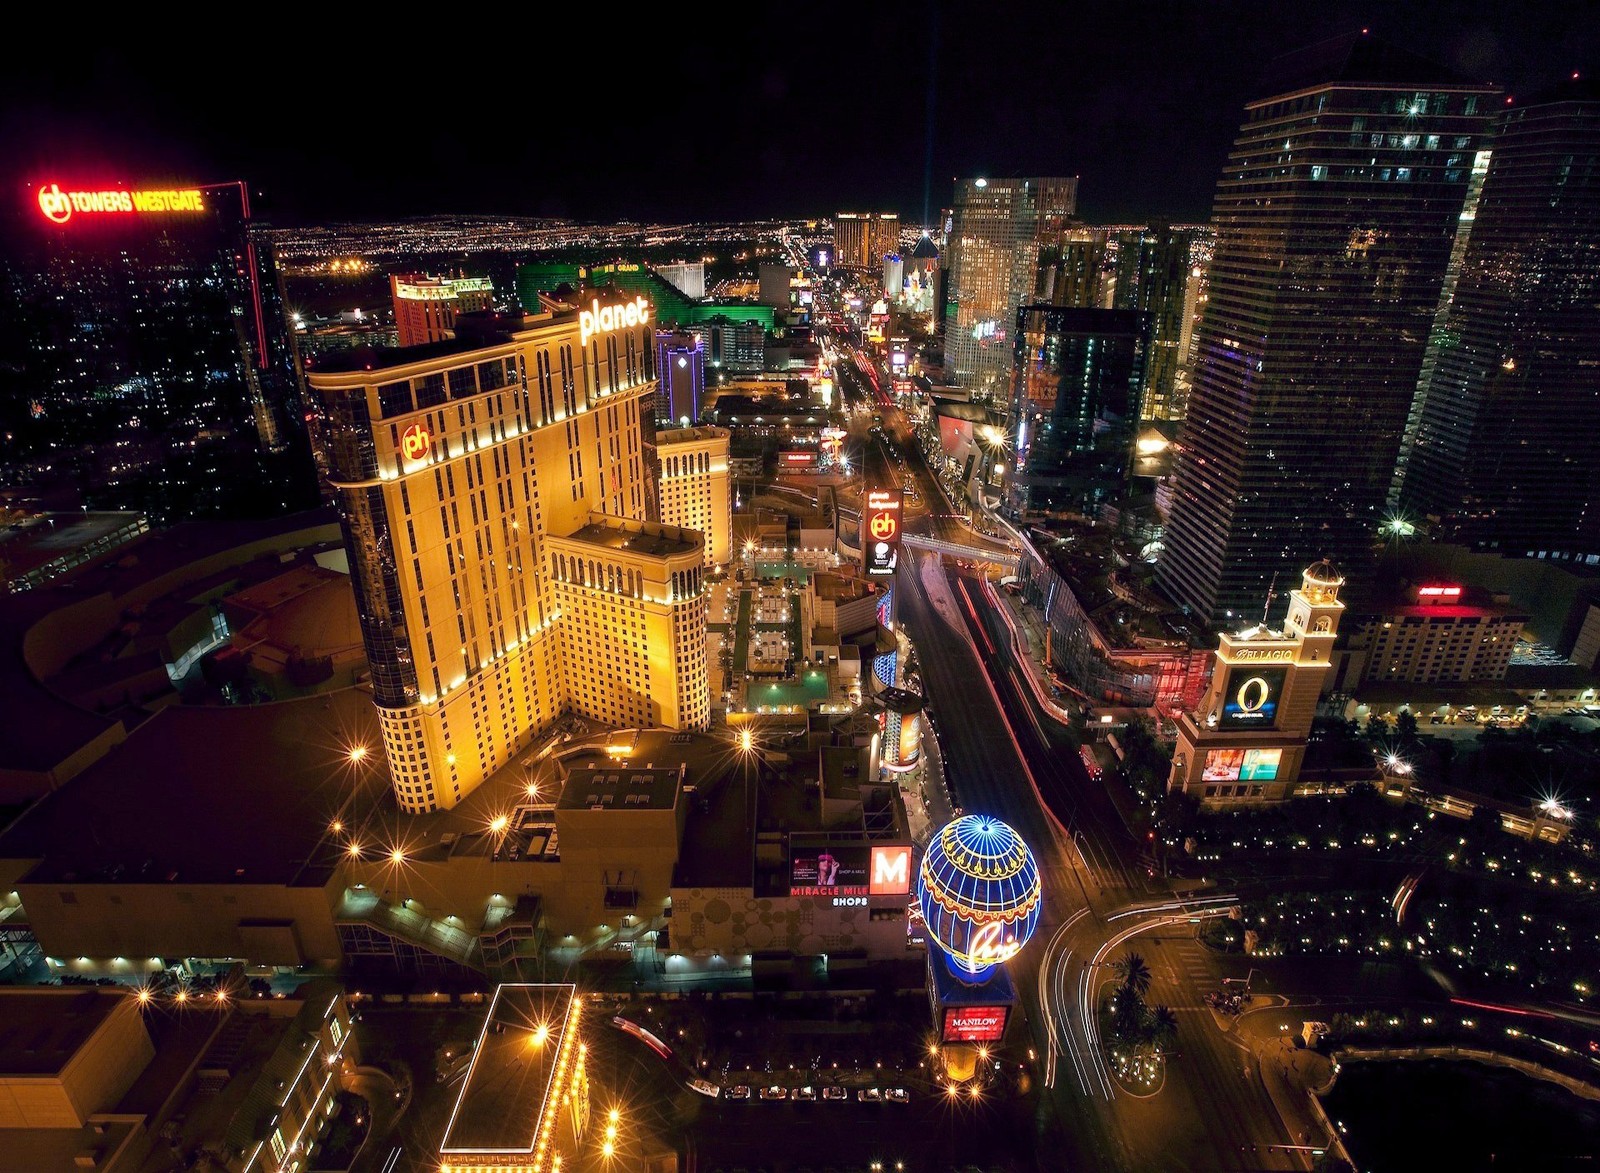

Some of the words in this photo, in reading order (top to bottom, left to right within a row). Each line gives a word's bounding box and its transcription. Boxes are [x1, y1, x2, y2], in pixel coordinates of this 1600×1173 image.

[69, 191, 133, 212] TOWERS
[131, 189, 204, 212] WESTGATE
[579, 295, 649, 347] planet
[402, 424, 430, 460] ph
[870, 512, 896, 540] ph
[1236, 677, 1269, 712] O
[874, 852, 908, 884] M
[790, 886, 839, 896] MIRACLE
[843, 886, 869, 896] MILE
[832, 897, 868, 907] SHOPS
[952, 1017, 998, 1026] MANILOW
